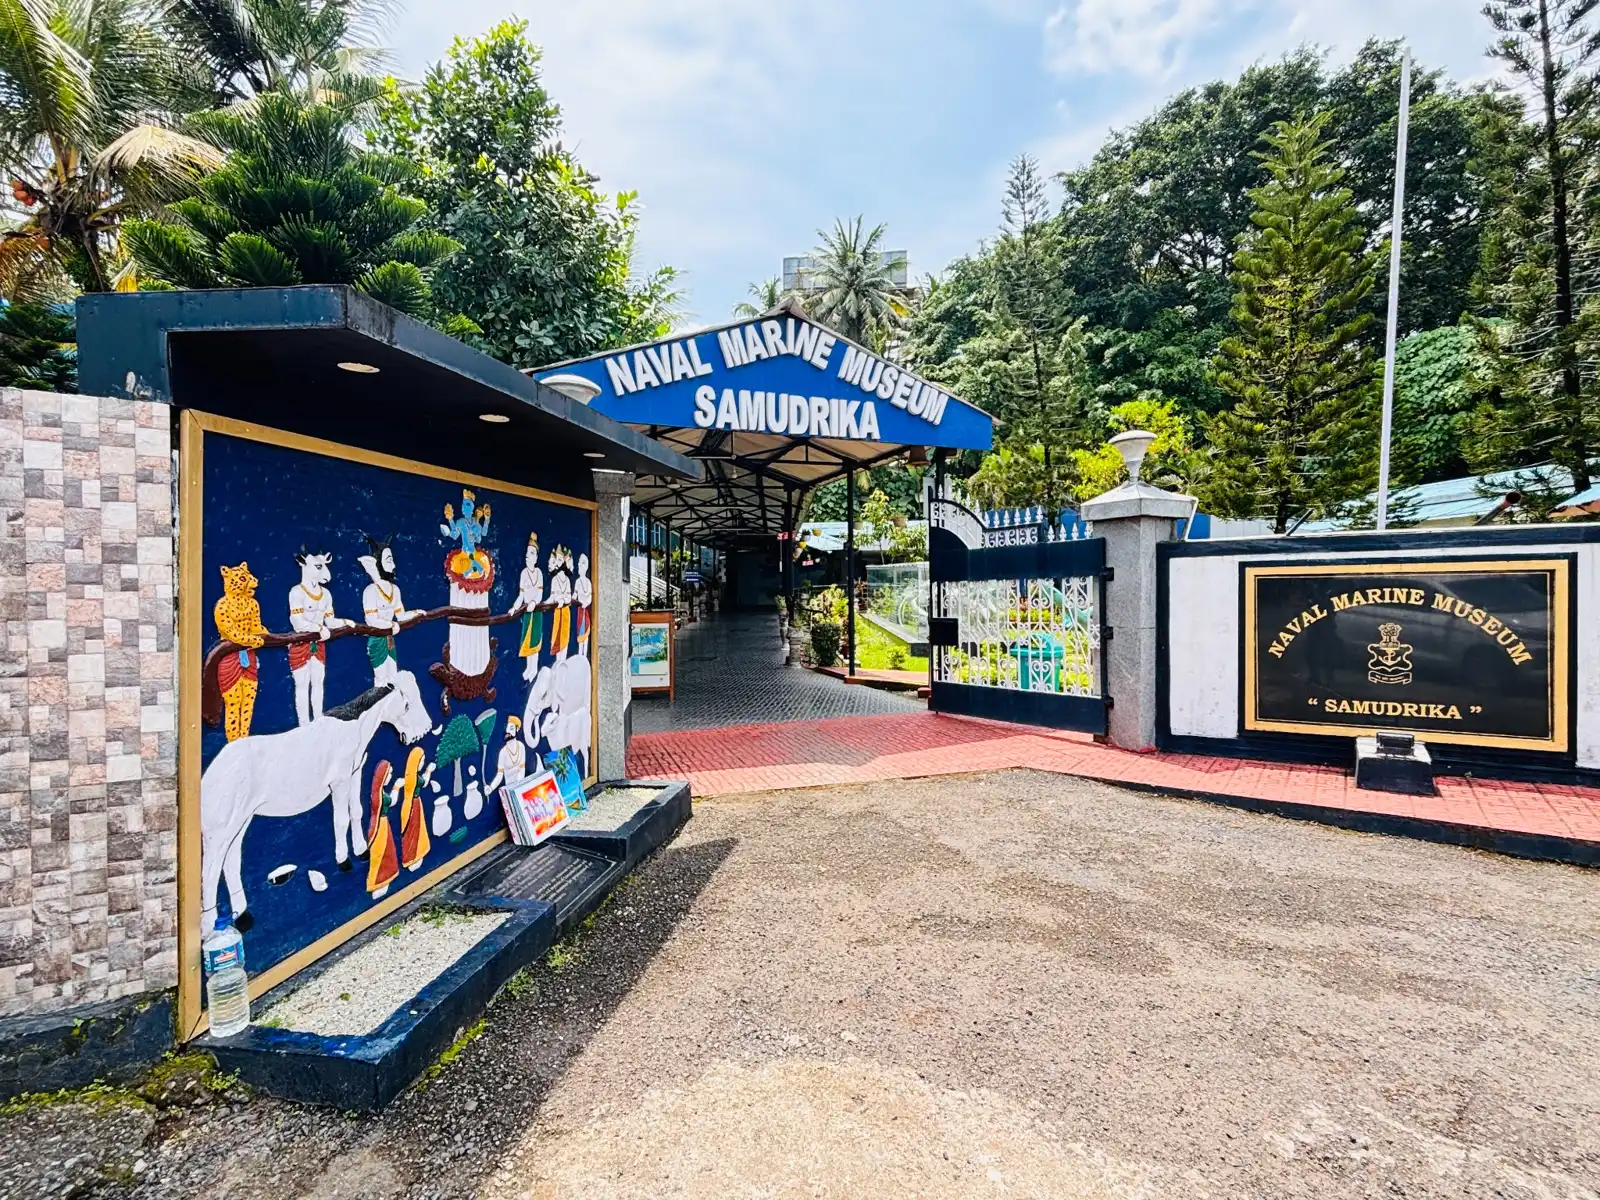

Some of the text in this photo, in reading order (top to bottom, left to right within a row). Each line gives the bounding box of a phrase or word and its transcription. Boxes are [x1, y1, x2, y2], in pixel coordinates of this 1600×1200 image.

[604, 318, 950, 426] NAVAL MARINE MUSEUM
[693, 385, 881, 440] SAMUDRIKA
[1267, 587, 1533, 666] NAVAL MARINE MUSEUM
